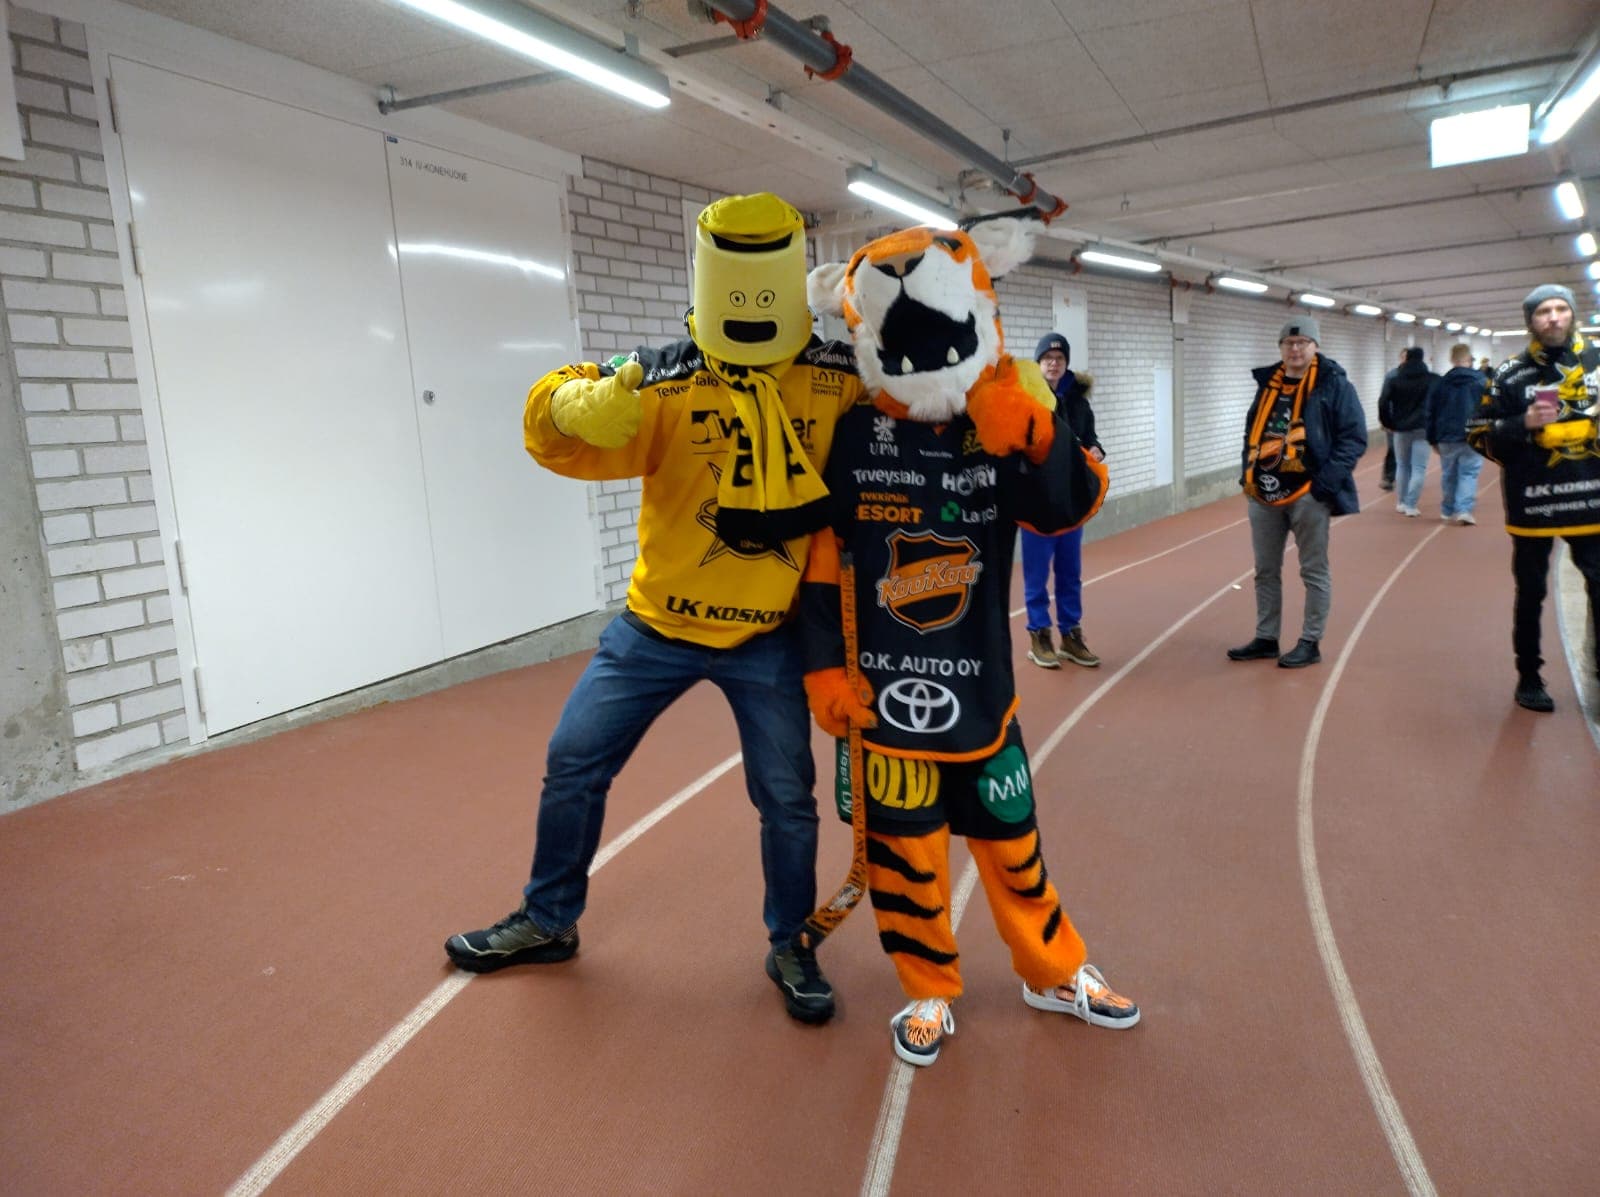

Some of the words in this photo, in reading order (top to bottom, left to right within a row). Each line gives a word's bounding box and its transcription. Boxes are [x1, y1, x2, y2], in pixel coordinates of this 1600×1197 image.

[869, 442, 899, 457] UPM
[860, 651, 896, 671] O.K.
[900, 655, 954, 676] AUTO
[957, 658, 983, 676] OY
[867, 752, 941, 810] OLVI
